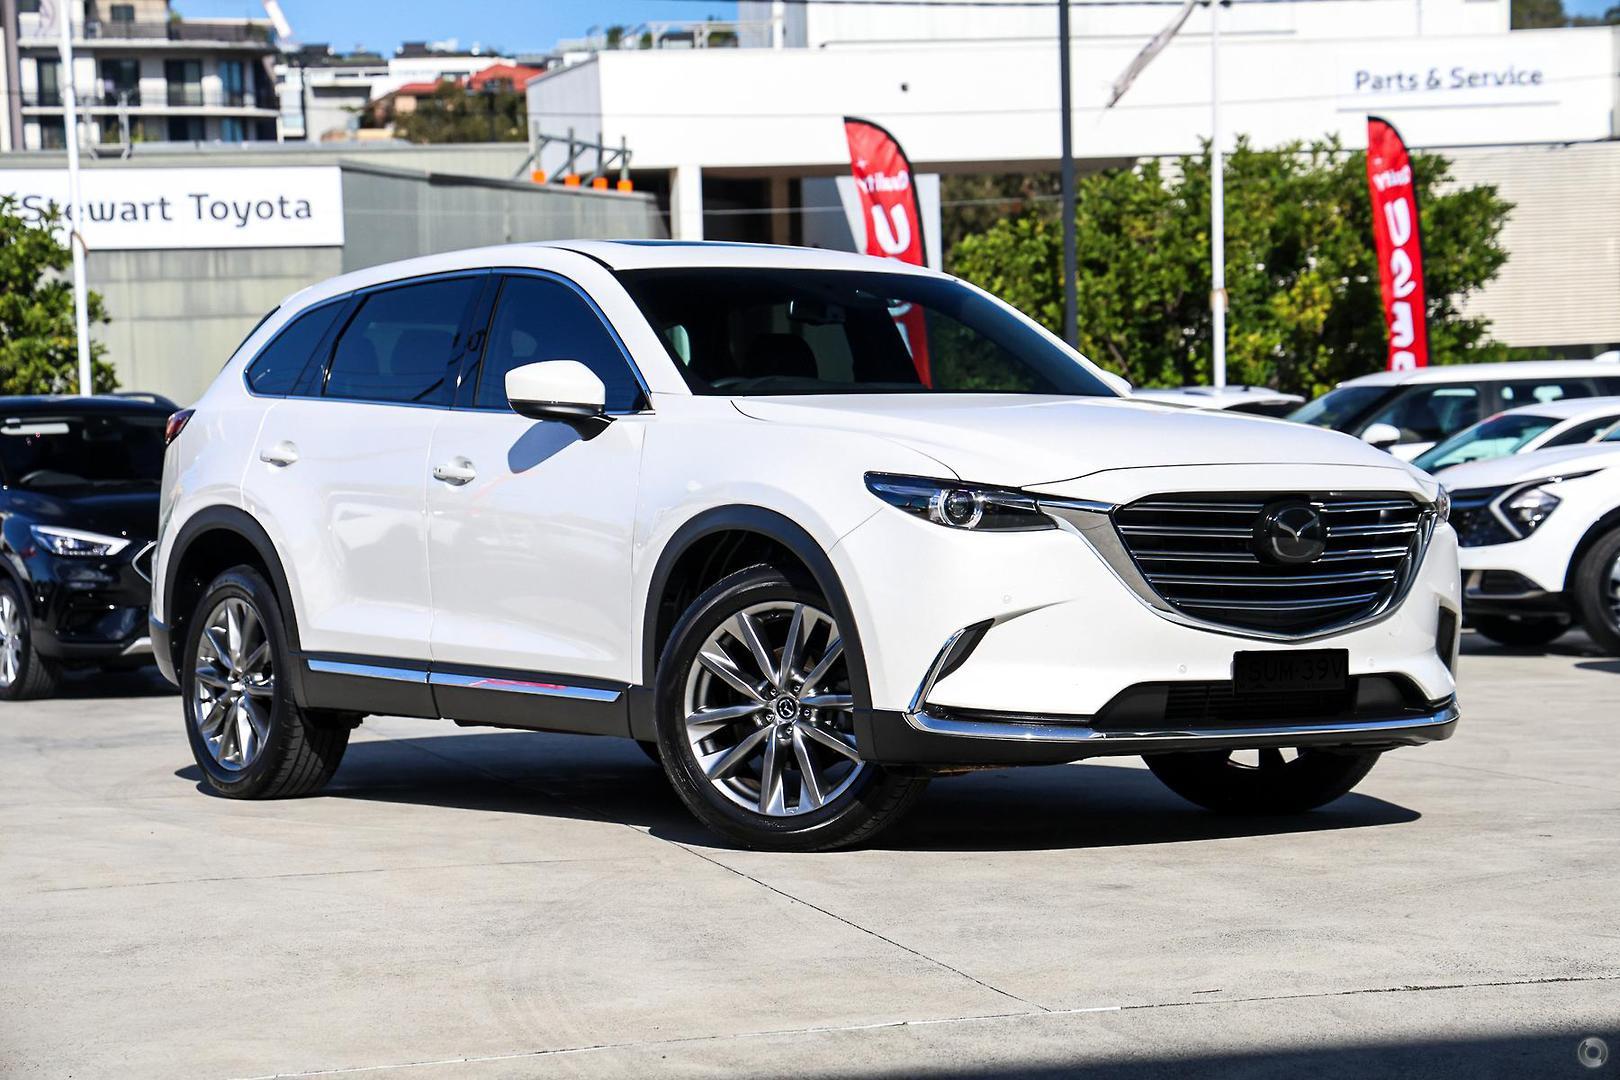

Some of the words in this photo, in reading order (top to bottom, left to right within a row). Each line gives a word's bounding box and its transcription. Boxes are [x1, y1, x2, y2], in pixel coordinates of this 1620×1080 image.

[1356, 70, 1418, 91] Parts
[1426, 67, 1442, 90] &
[1450, 65, 1544, 88] Service
[188, 194, 312, 227] Toyota
